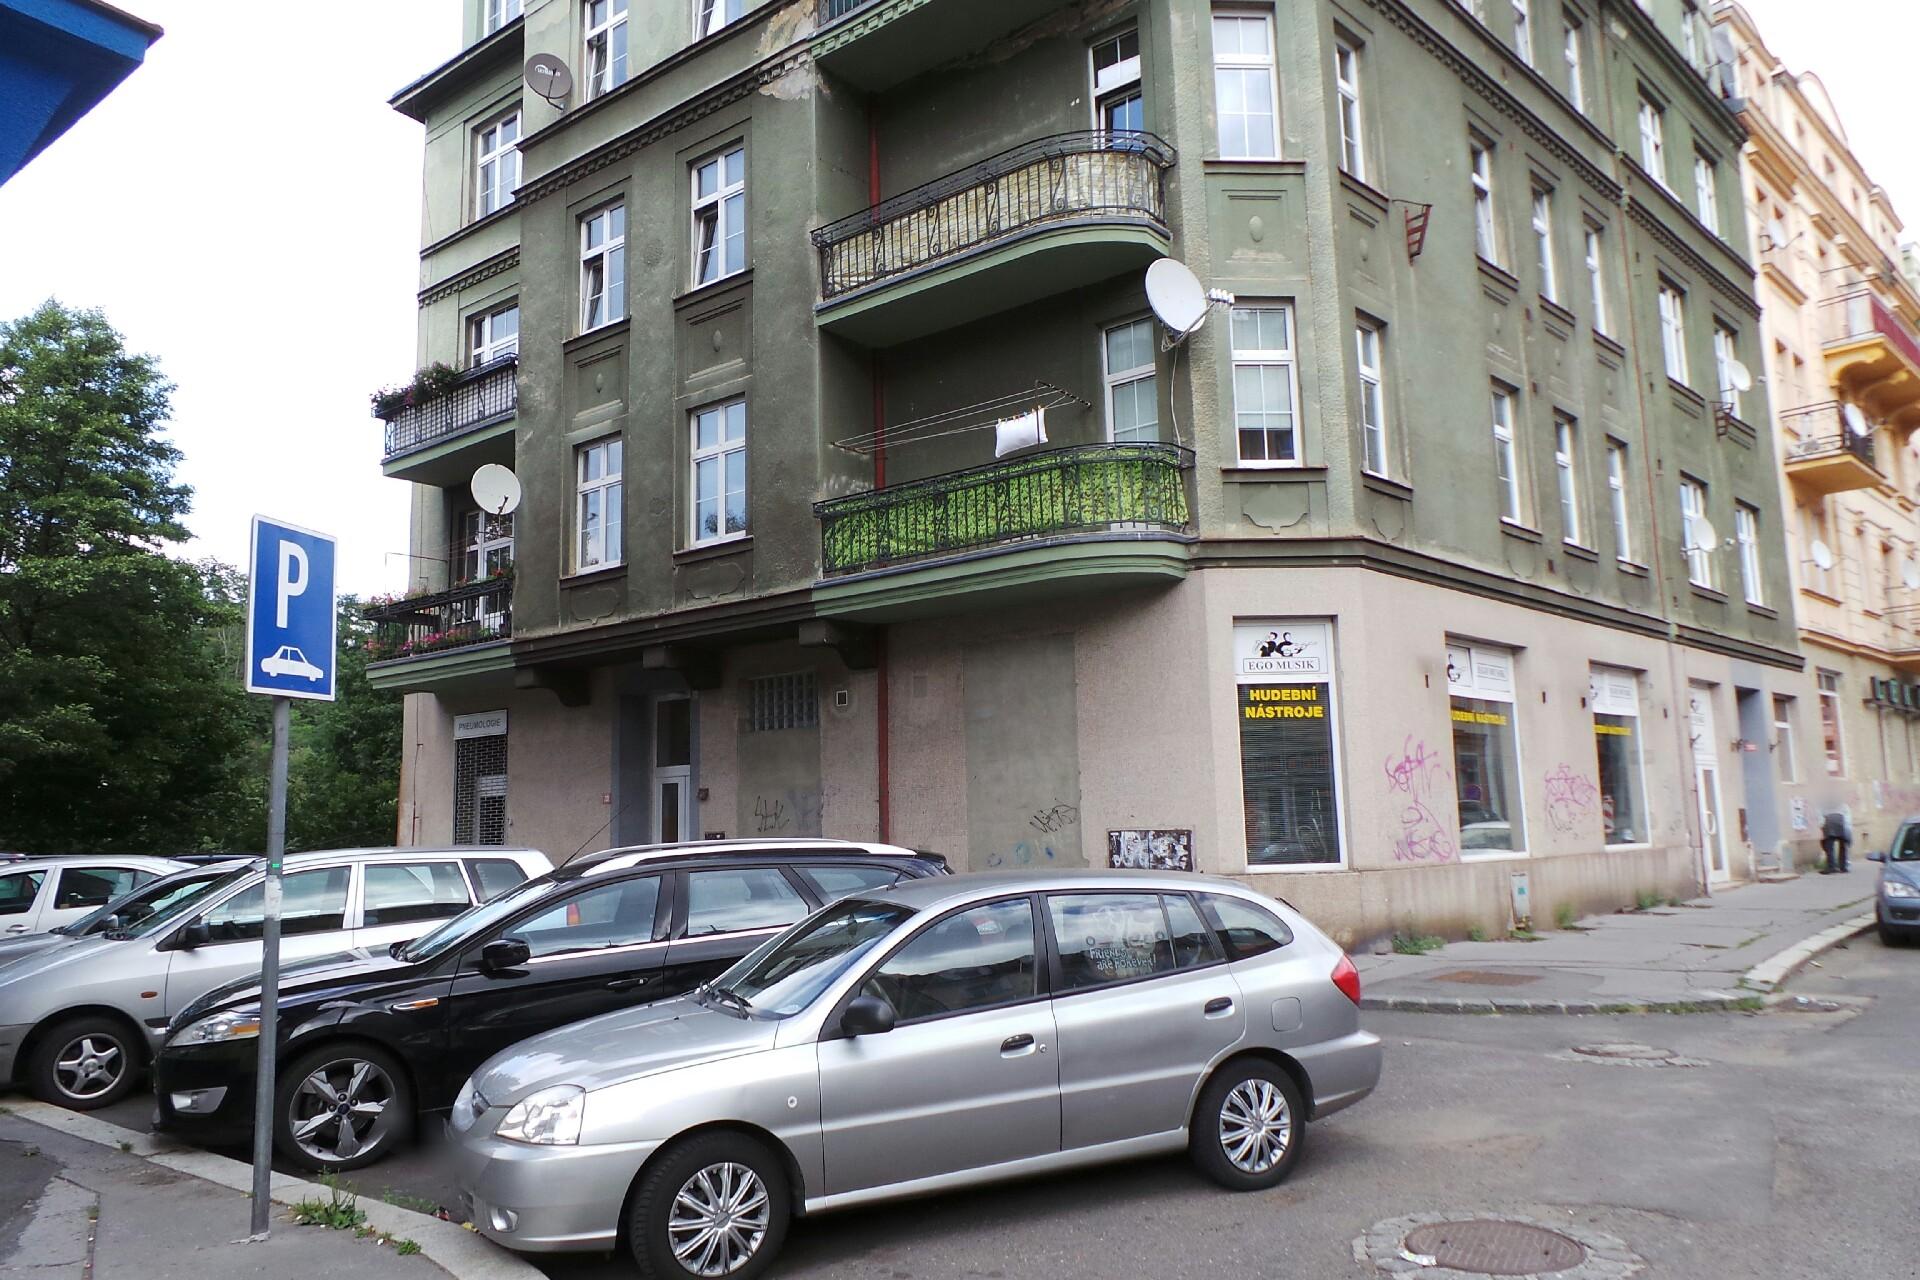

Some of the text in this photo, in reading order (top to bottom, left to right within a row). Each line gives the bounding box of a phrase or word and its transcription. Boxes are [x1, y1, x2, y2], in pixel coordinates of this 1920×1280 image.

[276, 539, 309, 629] P
[1248, 659, 1315, 671] EGO MUSIK
[1249, 685, 1317, 701] HUDEBNÍ
[1245, 703, 1324, 718] NÁSTROJE
[458, 718, 502, 731] PNEUMOLOGIE
